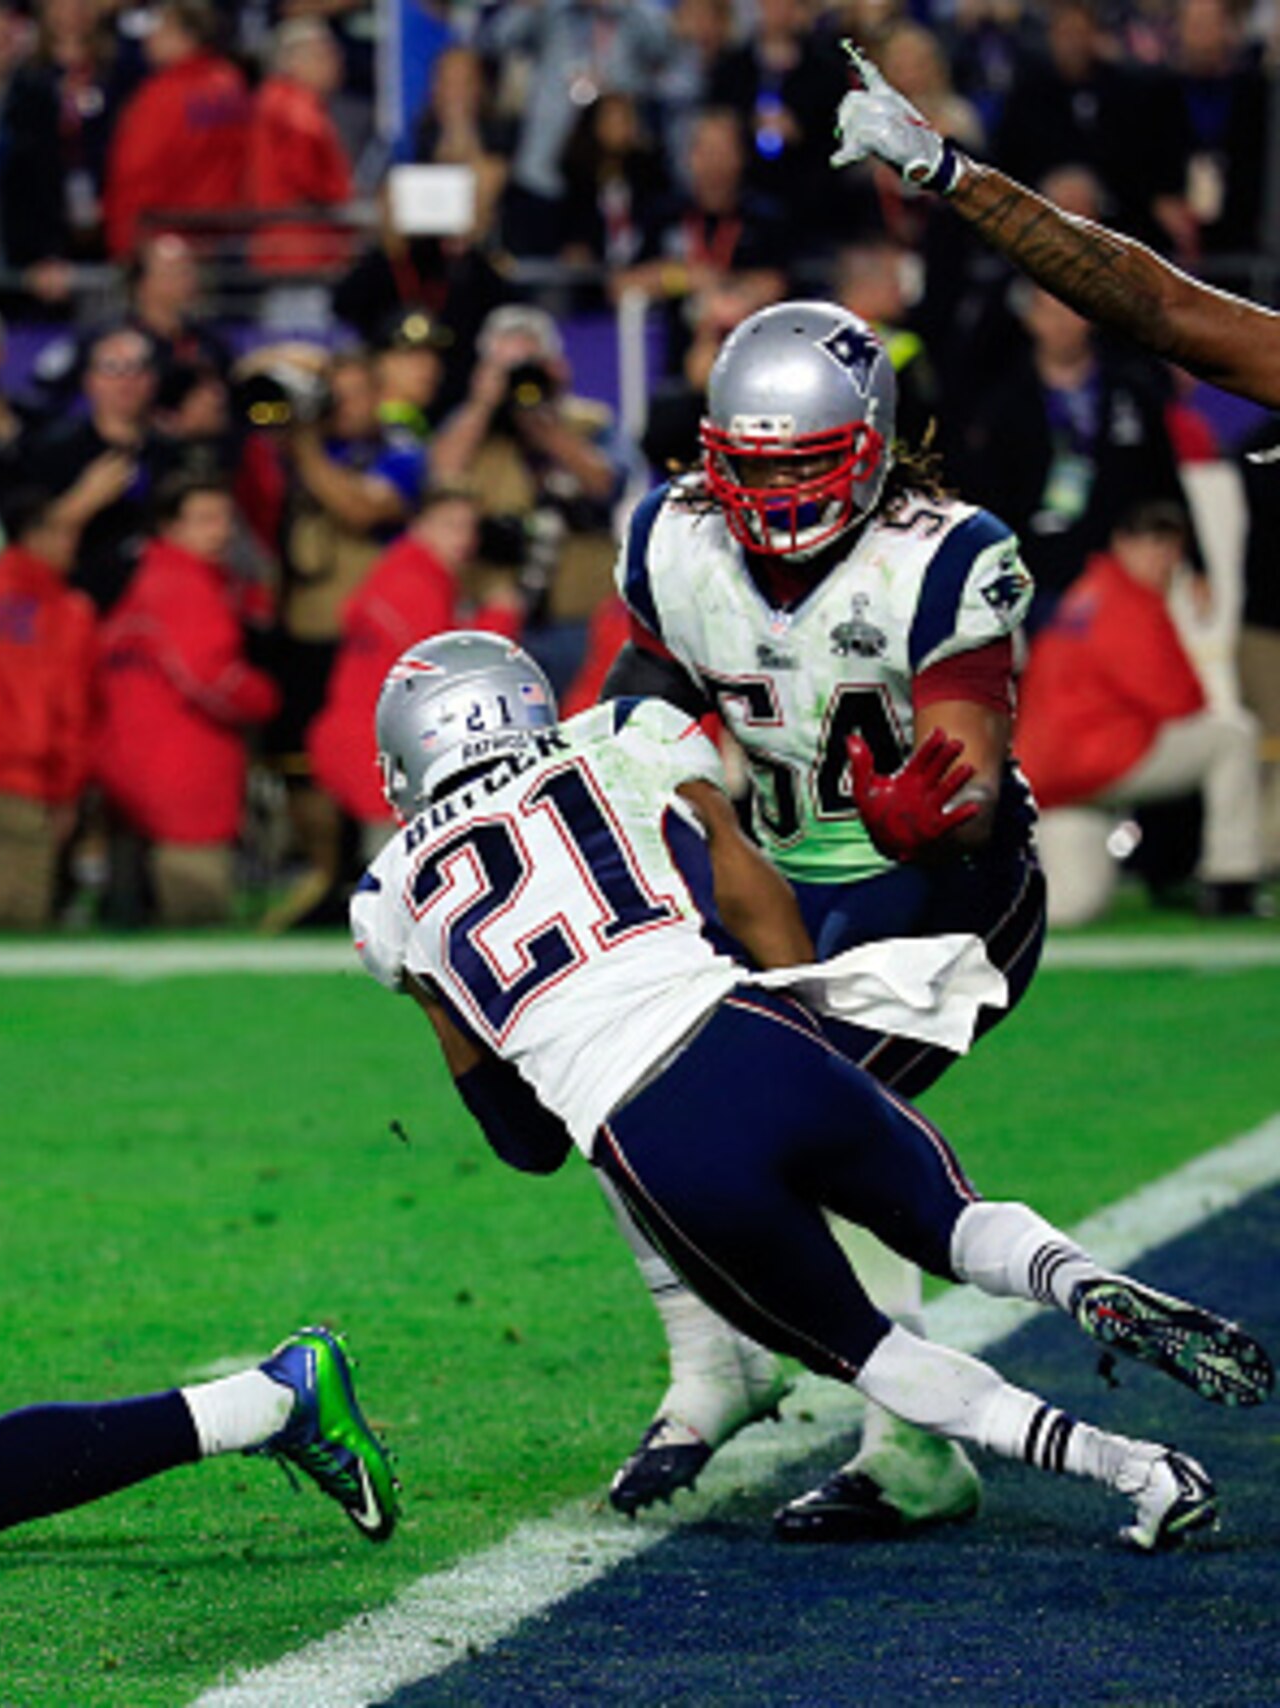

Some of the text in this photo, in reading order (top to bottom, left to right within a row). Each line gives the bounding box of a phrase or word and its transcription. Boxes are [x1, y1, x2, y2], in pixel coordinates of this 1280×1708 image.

[466, 694, 512, 732] 21
[696, 665, 910, 849] 54
[403, 755, 685, 1048] 21
